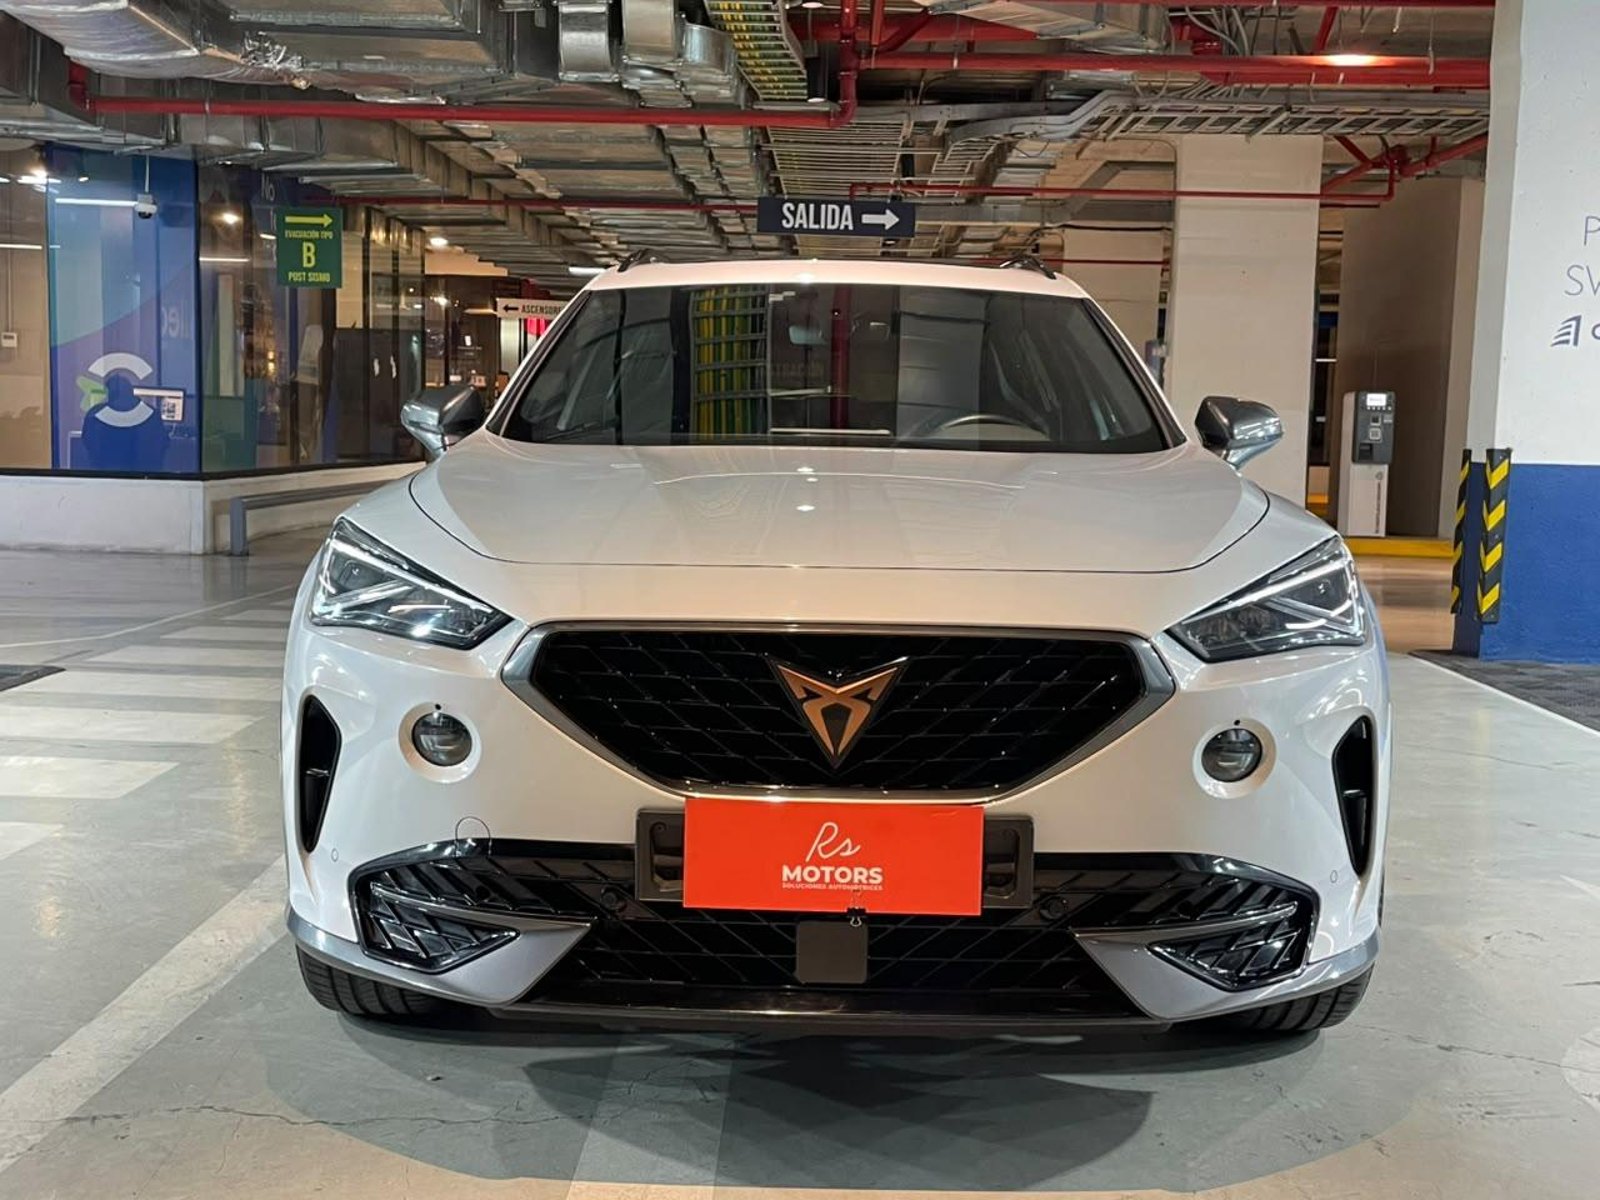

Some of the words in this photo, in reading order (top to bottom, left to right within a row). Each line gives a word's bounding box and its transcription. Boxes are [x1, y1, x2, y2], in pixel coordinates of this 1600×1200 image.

[782, 202, 853, 230] SALIDA
[302, 241, 316, 268] B
[288, 271, 306, 281] POST
[805, 821, 861, 862] Rs
[782, 865, 883, 884] MOTORS
